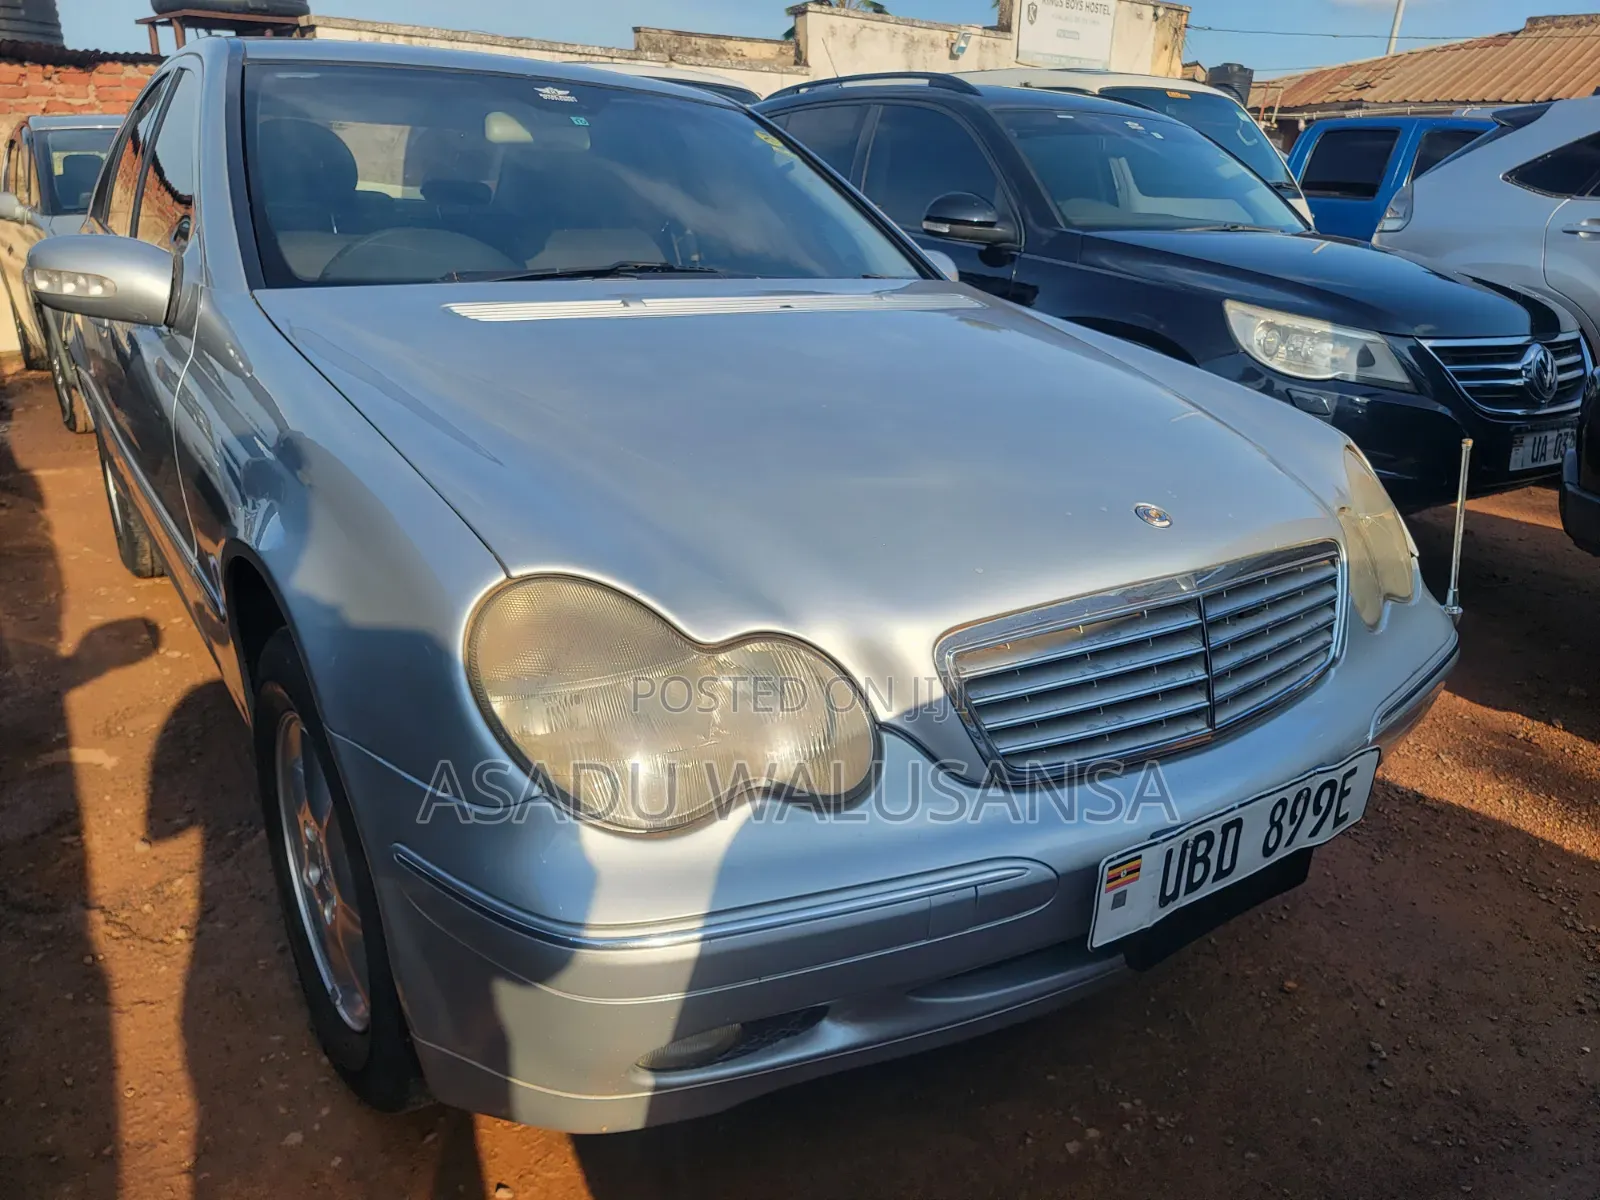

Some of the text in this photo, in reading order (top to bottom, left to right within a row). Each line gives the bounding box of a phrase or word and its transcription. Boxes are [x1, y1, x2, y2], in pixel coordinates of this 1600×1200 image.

[1065, 0, 1083, 11] BOYS
[1085, 2, 1111, 16] HOSTEL
[1531, 435, 1548, 463] UA
[1158, 765, 1358, 909] UBD 899E
